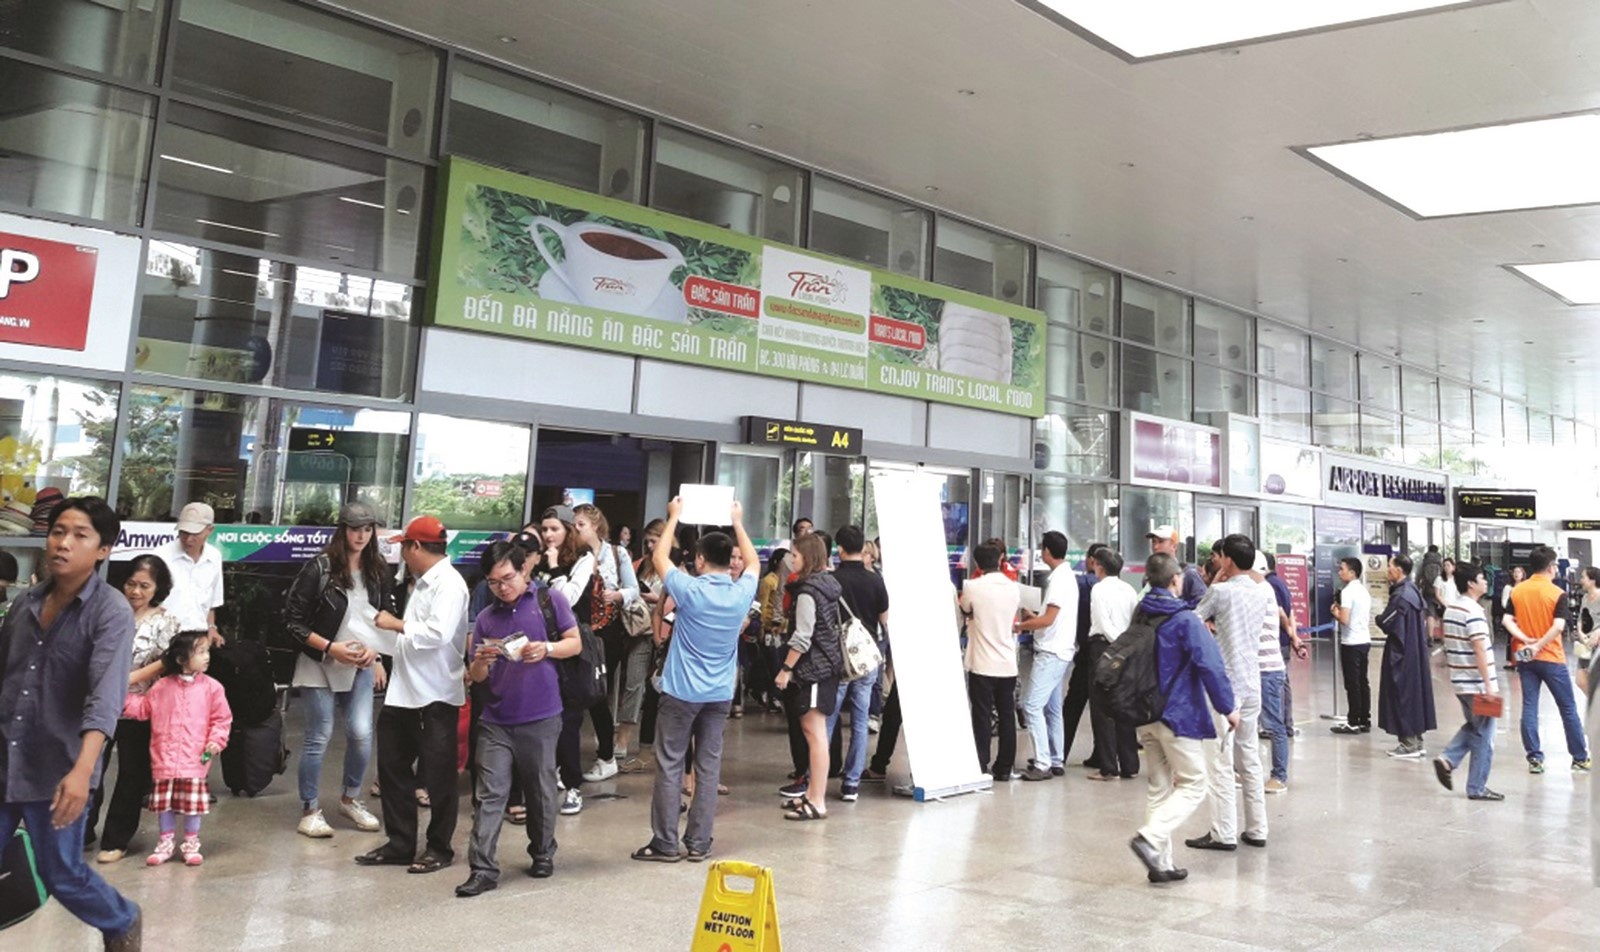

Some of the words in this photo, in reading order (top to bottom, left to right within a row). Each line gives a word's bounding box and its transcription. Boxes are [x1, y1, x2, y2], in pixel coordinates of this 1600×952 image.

[464, 293, 503, 324] ĐẾN
[512, 302, 538, 329] ĐÀ
[546, 306, 593, 338] NẴNG
[601, 317, 624, 343] ĂN
[631, 322, 663, 351] ĐẶC
[670, 329, 701, 356] SẢN
[709, 336, 747, 363] TRẦN
[880, 365, 920, 389] ENJOY
[925, 372, 965, 397] TRAN'S
[967, 381, 1002, 404] LOCAL
[1006, 389, 1033, 408] FOOD
[831, 430, 849, 449] A4
[240, 531, 272, 545] CUỘC
[711, 910, 752, 927] CAUTION
[704, 921, 724, 934] WET
[725, 925, 755, 940] FLOOR
